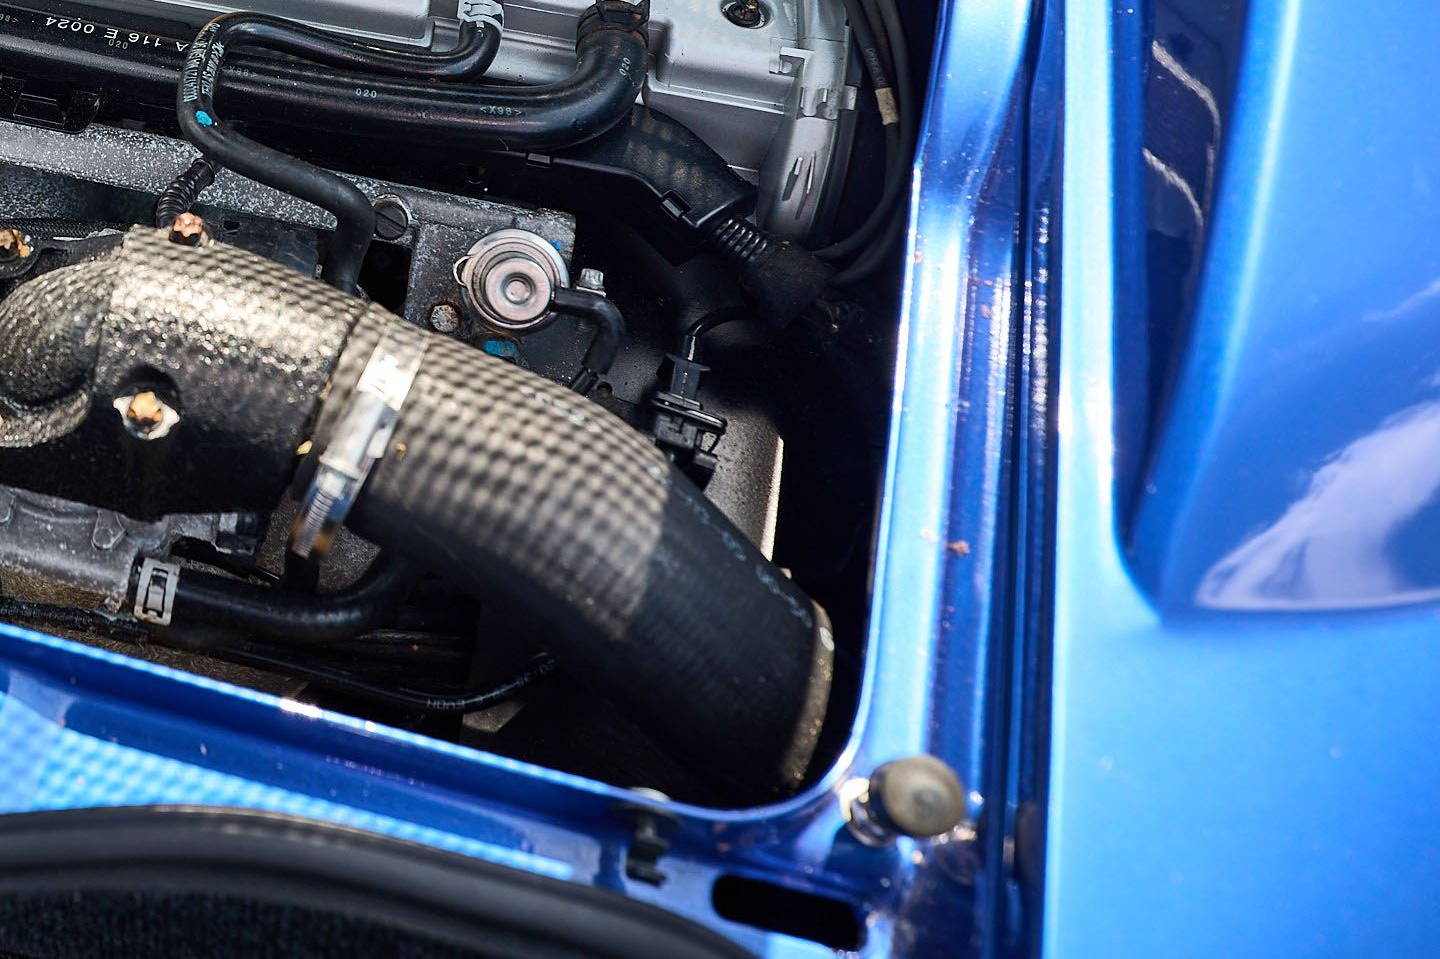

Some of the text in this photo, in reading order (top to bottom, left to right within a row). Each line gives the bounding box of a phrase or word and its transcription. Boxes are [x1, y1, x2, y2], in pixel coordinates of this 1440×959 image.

[45, 15, 189, 52] A 116 E 0024
[619, 57, 631, 76] 020
[355, 87, 378, 99] 020
[479, 105, 523, 117] <X98>
